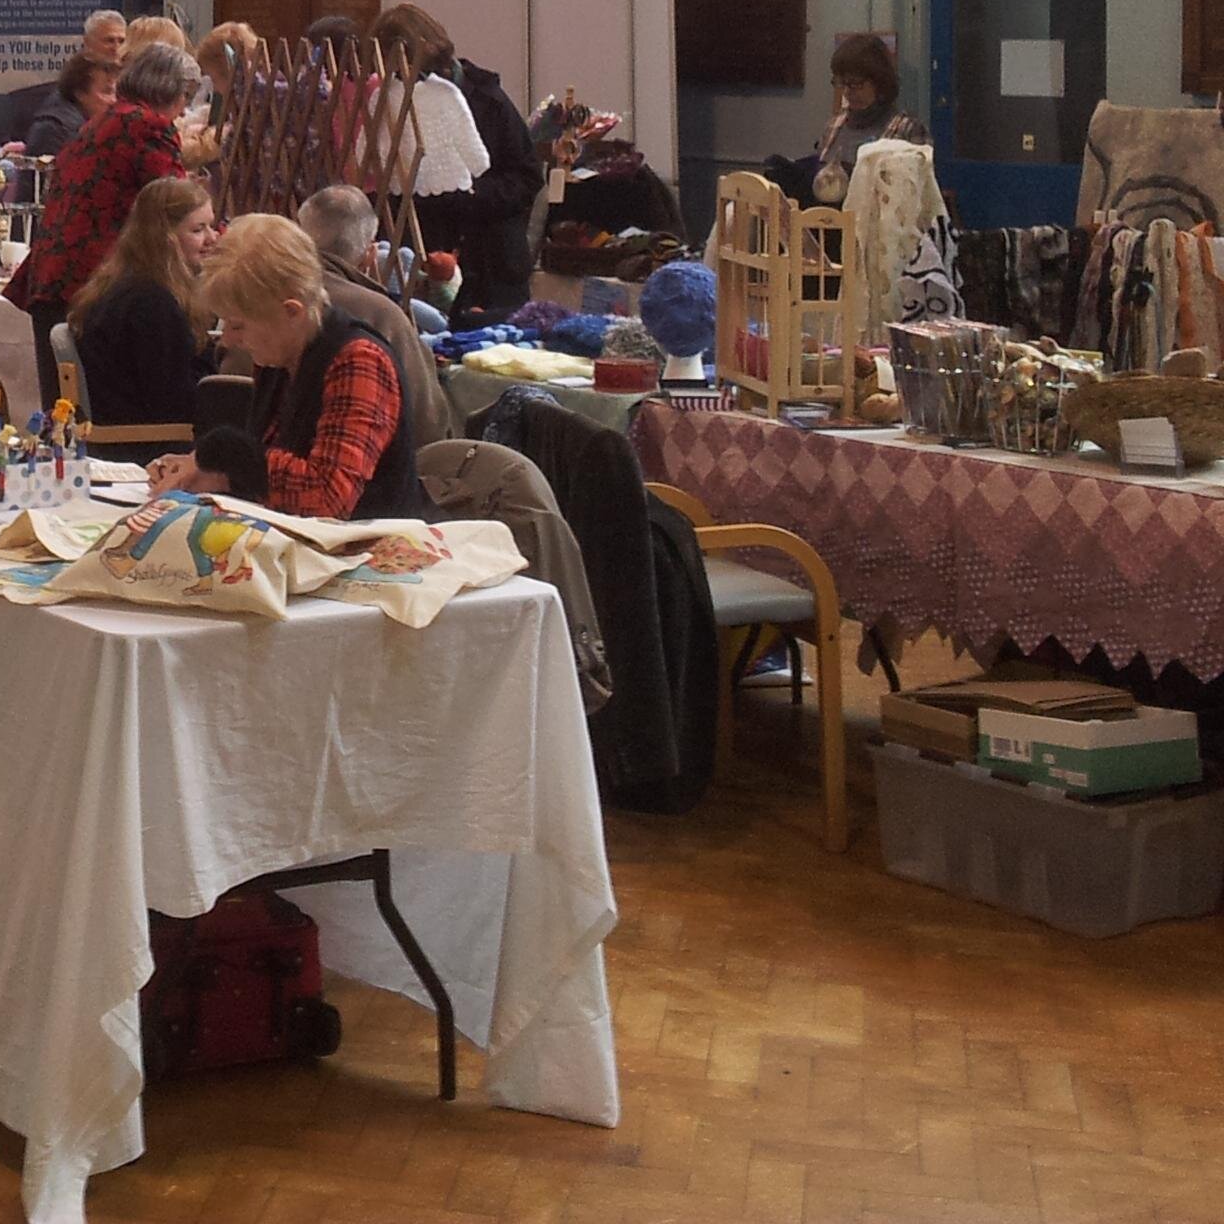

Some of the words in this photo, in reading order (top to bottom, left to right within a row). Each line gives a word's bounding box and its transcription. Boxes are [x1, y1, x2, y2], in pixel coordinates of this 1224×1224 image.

[9, 41, 32, 53] YOU
[35, 42, 61, 56] help
[64, 44, 77, 54] us
[12, 59, 44, 70] these
